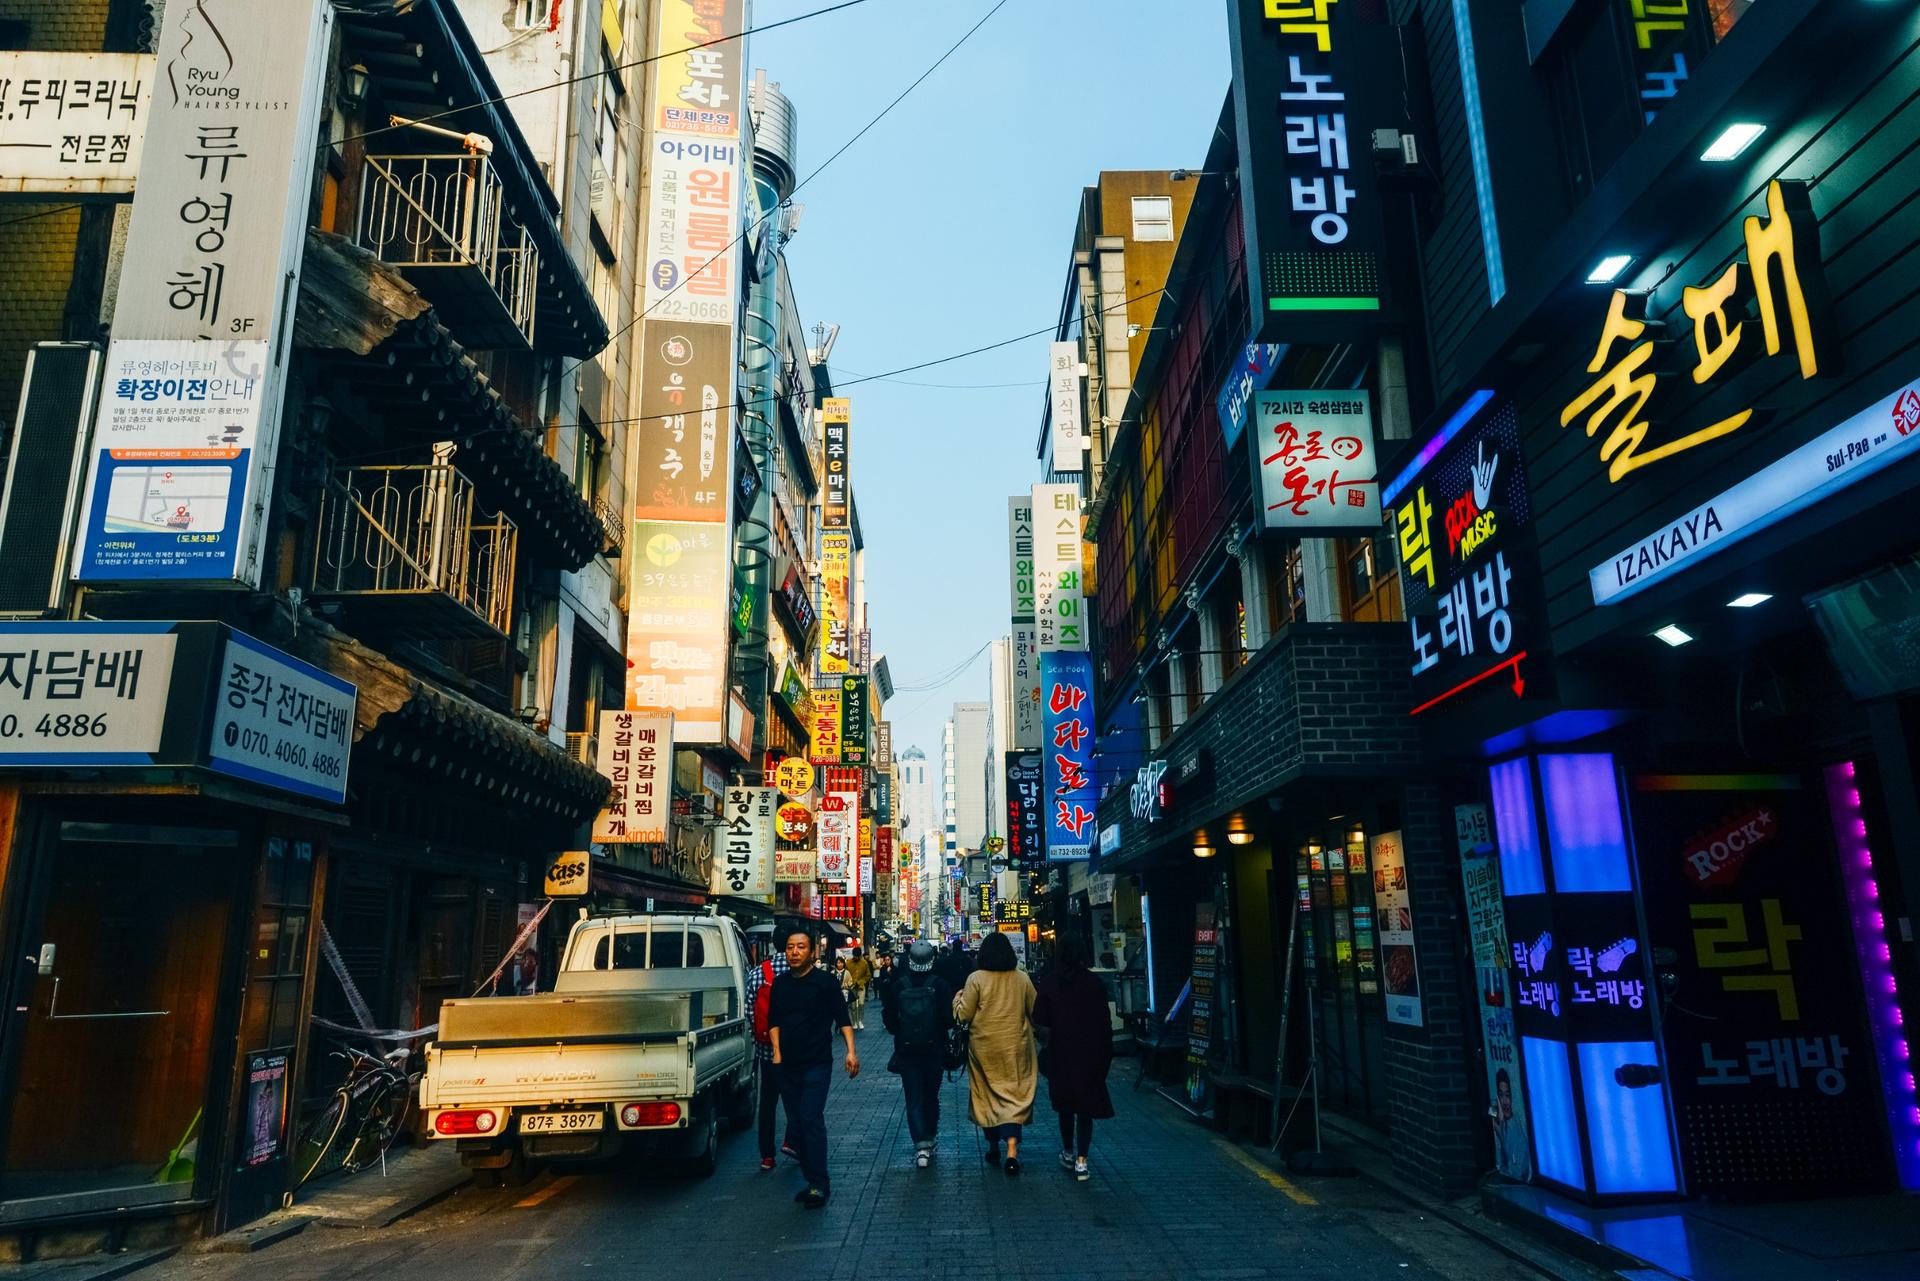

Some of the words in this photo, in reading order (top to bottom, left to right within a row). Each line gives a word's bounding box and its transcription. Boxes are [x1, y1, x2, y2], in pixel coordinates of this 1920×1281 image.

[677, 0, 729, 107] 구포차
[185, 84, 240, 99] Young
[187, 68, 219, 82] Ryu
[0, 79, 141, 120] .두피크리닉
[666, 109, 730, 125] 단체환영
[60, 135, 131, 163] 전문점
[660, 141, 734, 165] 아이비
[1280, 56, 1356, 243] 노래방
[166, 126, 248, 340] 류영헤
[658, 207, 676, 256] 레지던스
[684, 169, 731, 296] 원룸텔
[230, 318, 255, 333] 3F
[652, 298, 729, 319] 722-0666
[1056, 355, 1078, 439] 화포식당
[1261, 401, 1304, 415] 72시간
[1308, 401, 1364, 415] 숙성삼겹살
[1826, 437, 1870, 472] Sul-Pae
[695, 491, 716, 504] 4F
[1397, 486, 1435, 589] 락
[1616, 506, 1723, 587] IZAKAYA
[1015, 508, 1036, 612] 테스트와이즈
[1054, 493, 1080, 645] 테스트와이즈
[1039, 571, 1054, 645] 시사영어학원
[1411, 551, 1512, 678] 노래방
[0, 650, 143, 699] 자담배
[1016, 631, 1029, 679] 프랑스어
[228, 662, 272, 718] 종각
[276, 683, 348, 746] 전자담배
[815, 693, 840, 702] 대신
[35, 713, 107, 738] 4886
[816, 704, 838, 745] 부동산
[242, 731, 270, 759] 070.
[275, 742, 309, 770] 4060.
[313, 755, 341, 778] 4886
[635, 729, 656, 815] 매운갈비찜
[781, 766, 808, 777] 맥주
[1049, 683, 1094, 839] 바다포차
[758, 791, 771, 816] 종로
[781, 779, 807, 789] 마트
[625, 826, 666, 842] kimchi
[726, 790, 755, 891] 황소곱창
[782, 822, 808, 833] 포차
[1688, 815, 1765, 881] ROCK
[1512, 942, 1531, 979] 락
[1567, 947, 1594, 978] 락
[1688, 898, 1803, 1021] 락
[1519, 981, 1560, 1017] 노래방
[1572, 979, 1645, 1009] 노래방
[1697, 1034, 1849, 1096] 노래방
[527, 1118, 554, 1132] 87주
[560, 1114, 596, 1130] 3897
